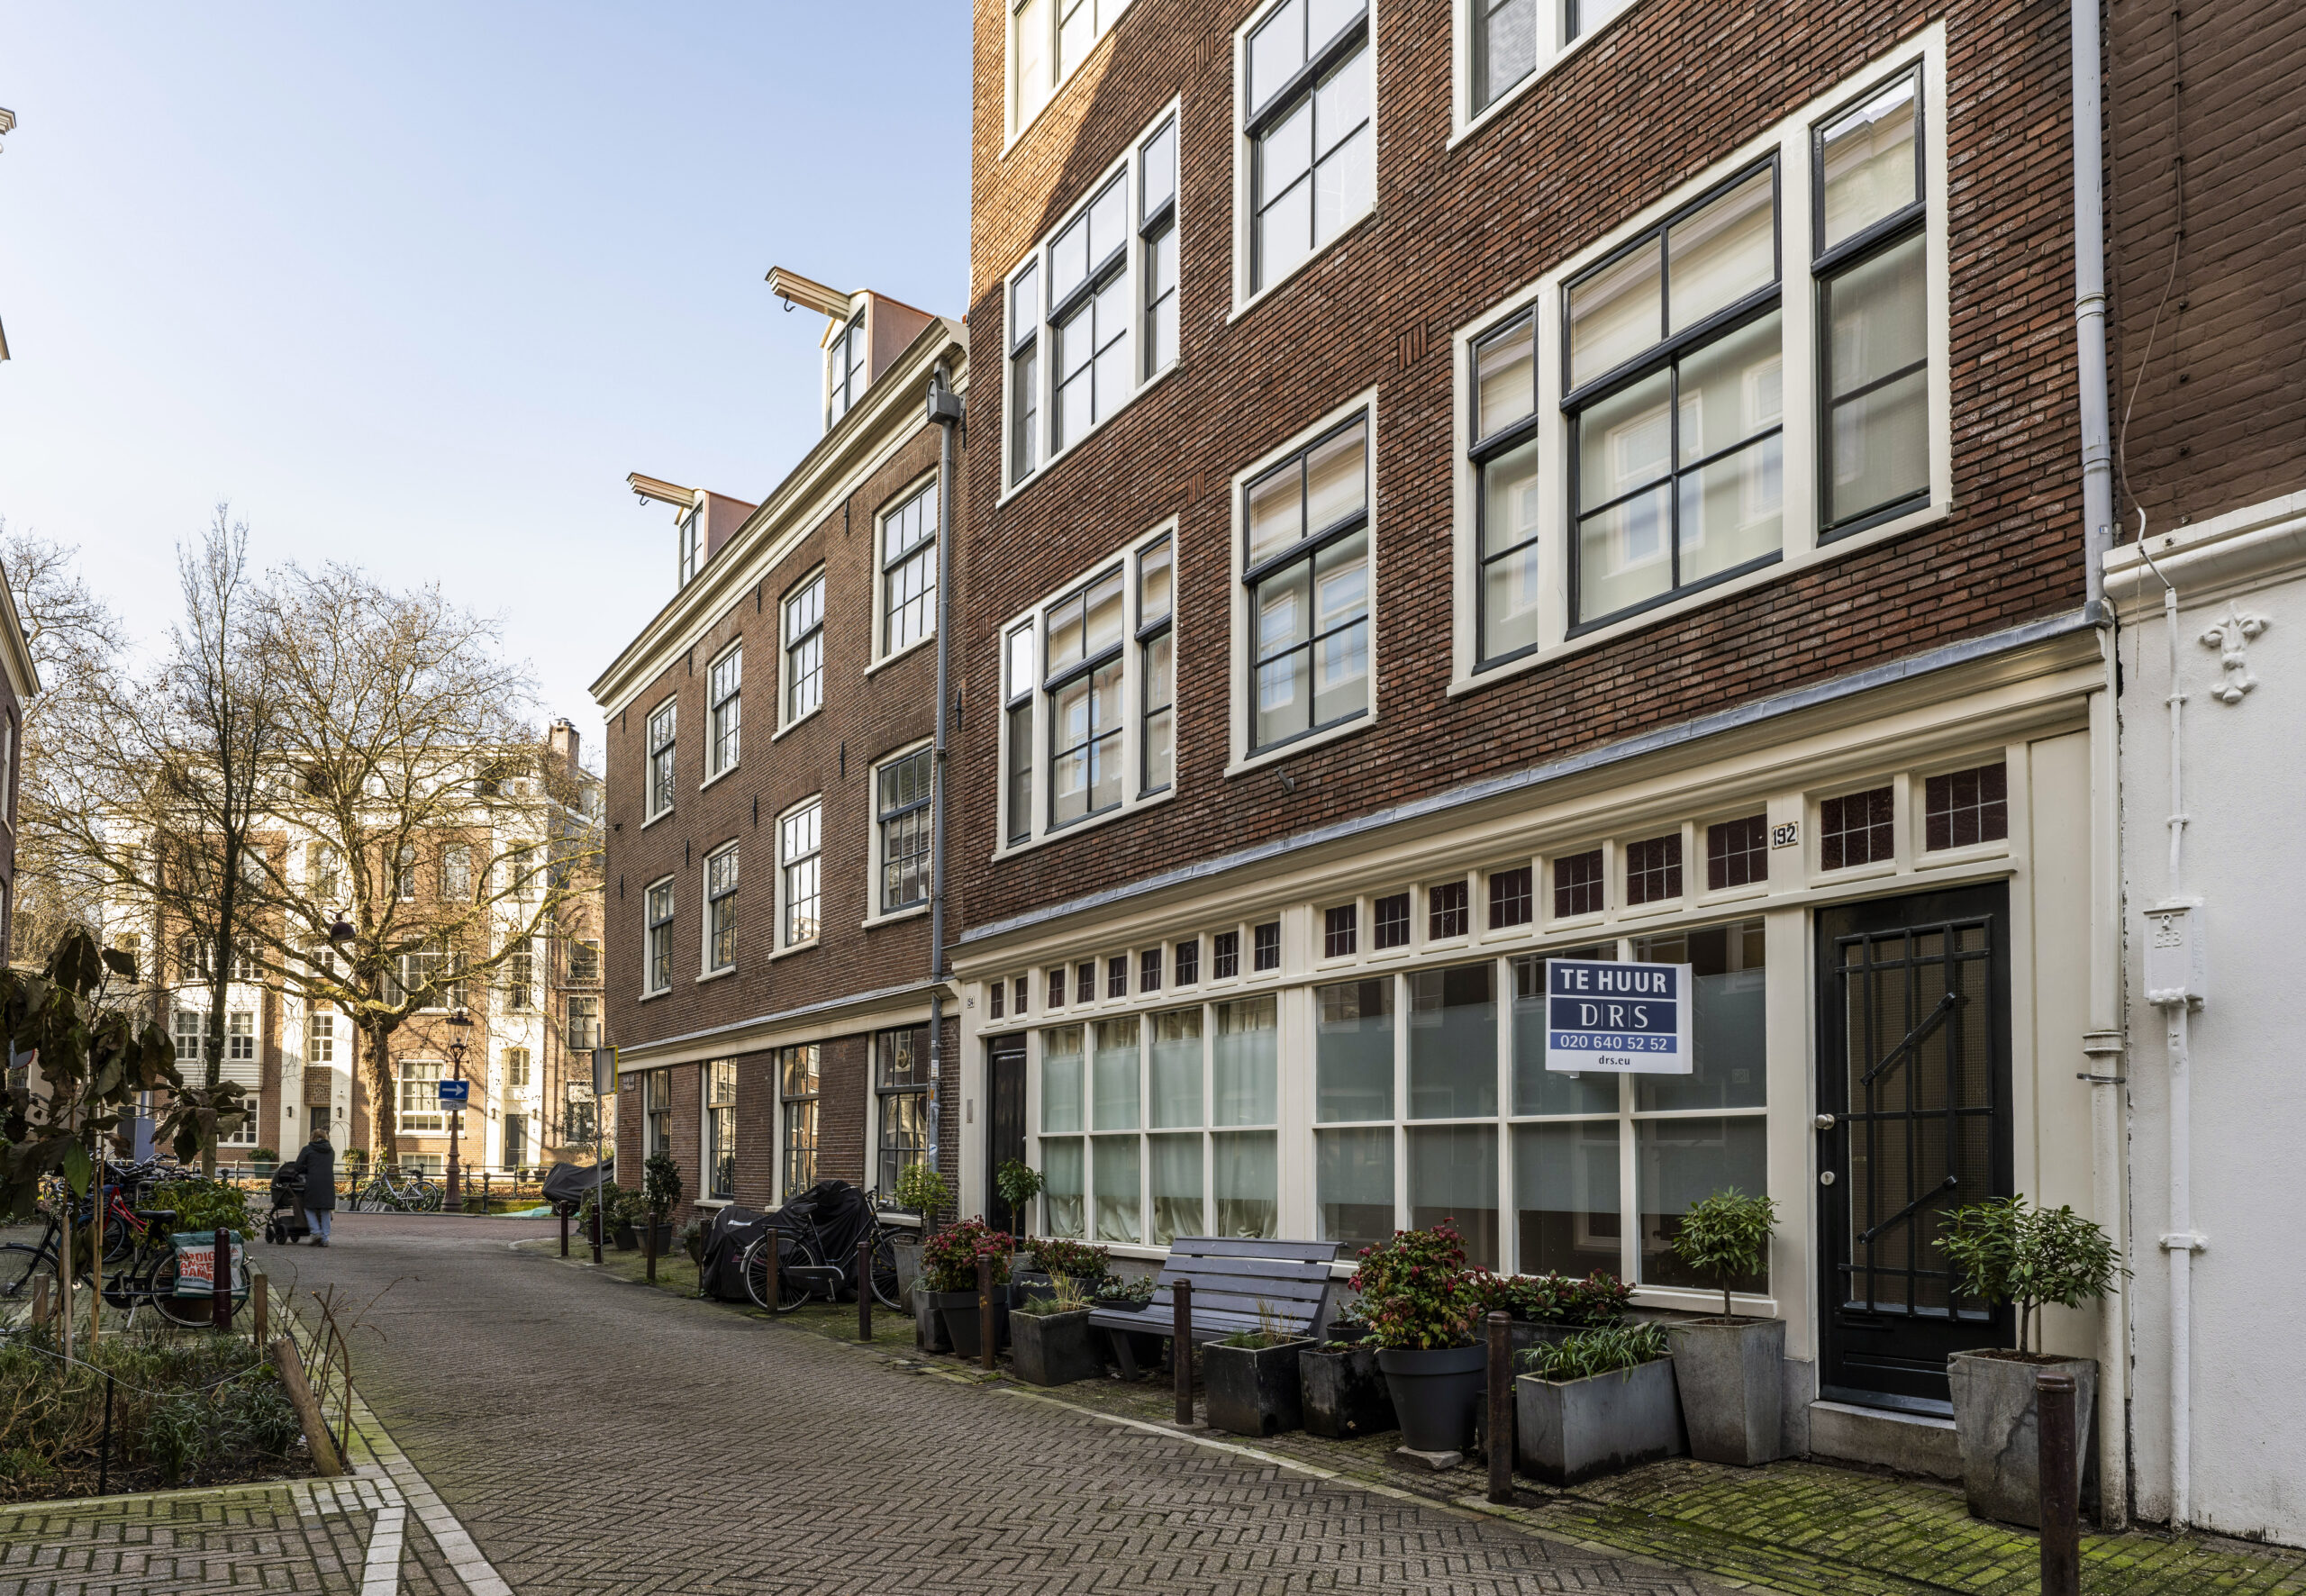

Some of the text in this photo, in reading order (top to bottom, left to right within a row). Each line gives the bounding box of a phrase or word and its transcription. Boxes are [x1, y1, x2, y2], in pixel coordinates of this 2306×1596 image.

[1773, 825, 1795, 846] 192
[1560, 968, 1666, 993] TE HUUR
[1560, 1035, 1667, 1051] 020 640 52 52
[1598, 1055, 1630, 1066] drs.eu
